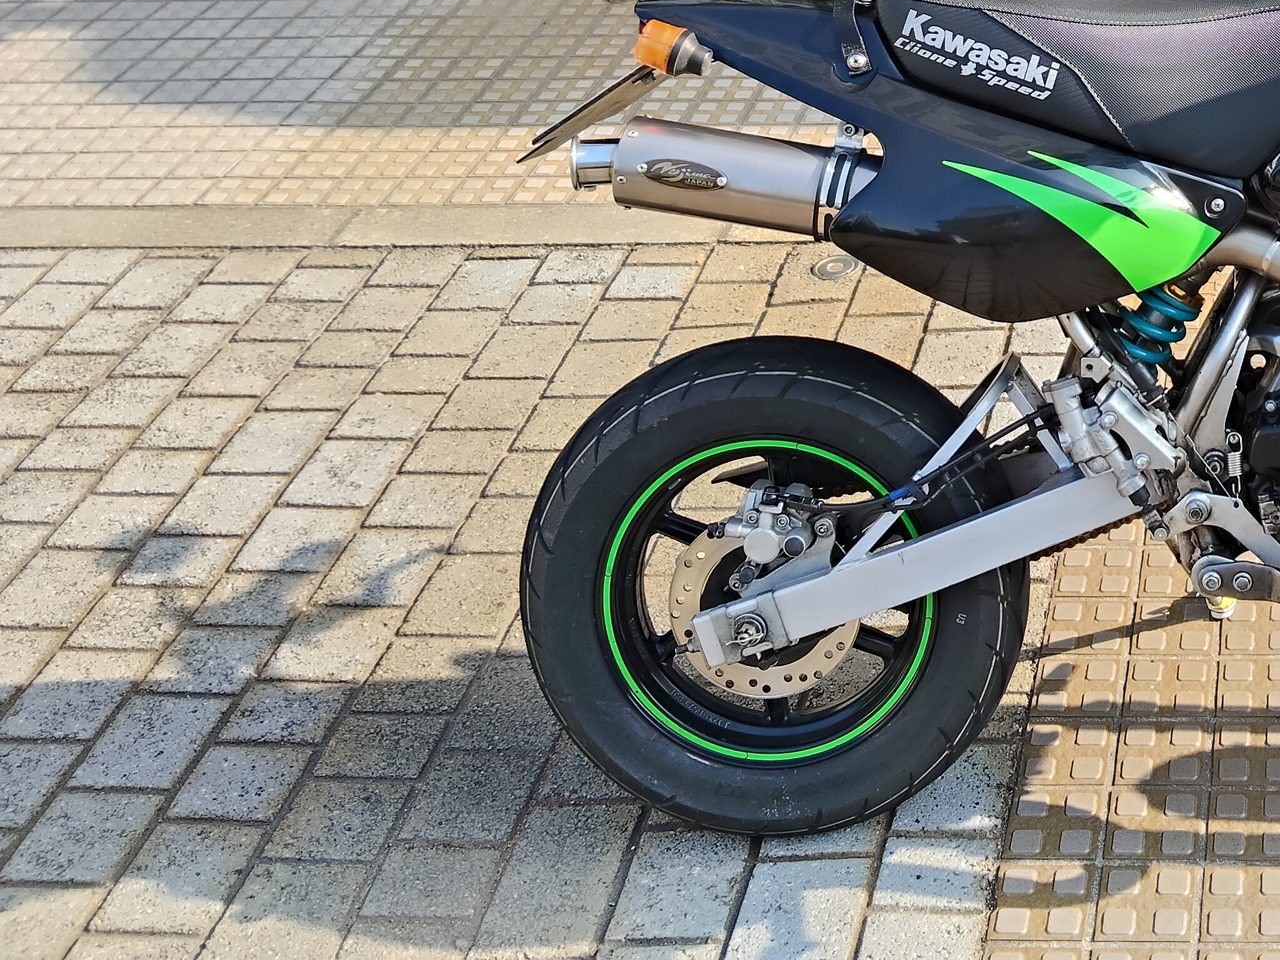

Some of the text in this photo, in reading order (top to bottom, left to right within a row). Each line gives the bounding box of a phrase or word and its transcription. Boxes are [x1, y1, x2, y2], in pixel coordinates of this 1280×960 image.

[894, 36, 1052, 101] Clione Speed
[901, 8, 1061, 90] Kawasaki
[684, 178, 714, 187] JAPAN
